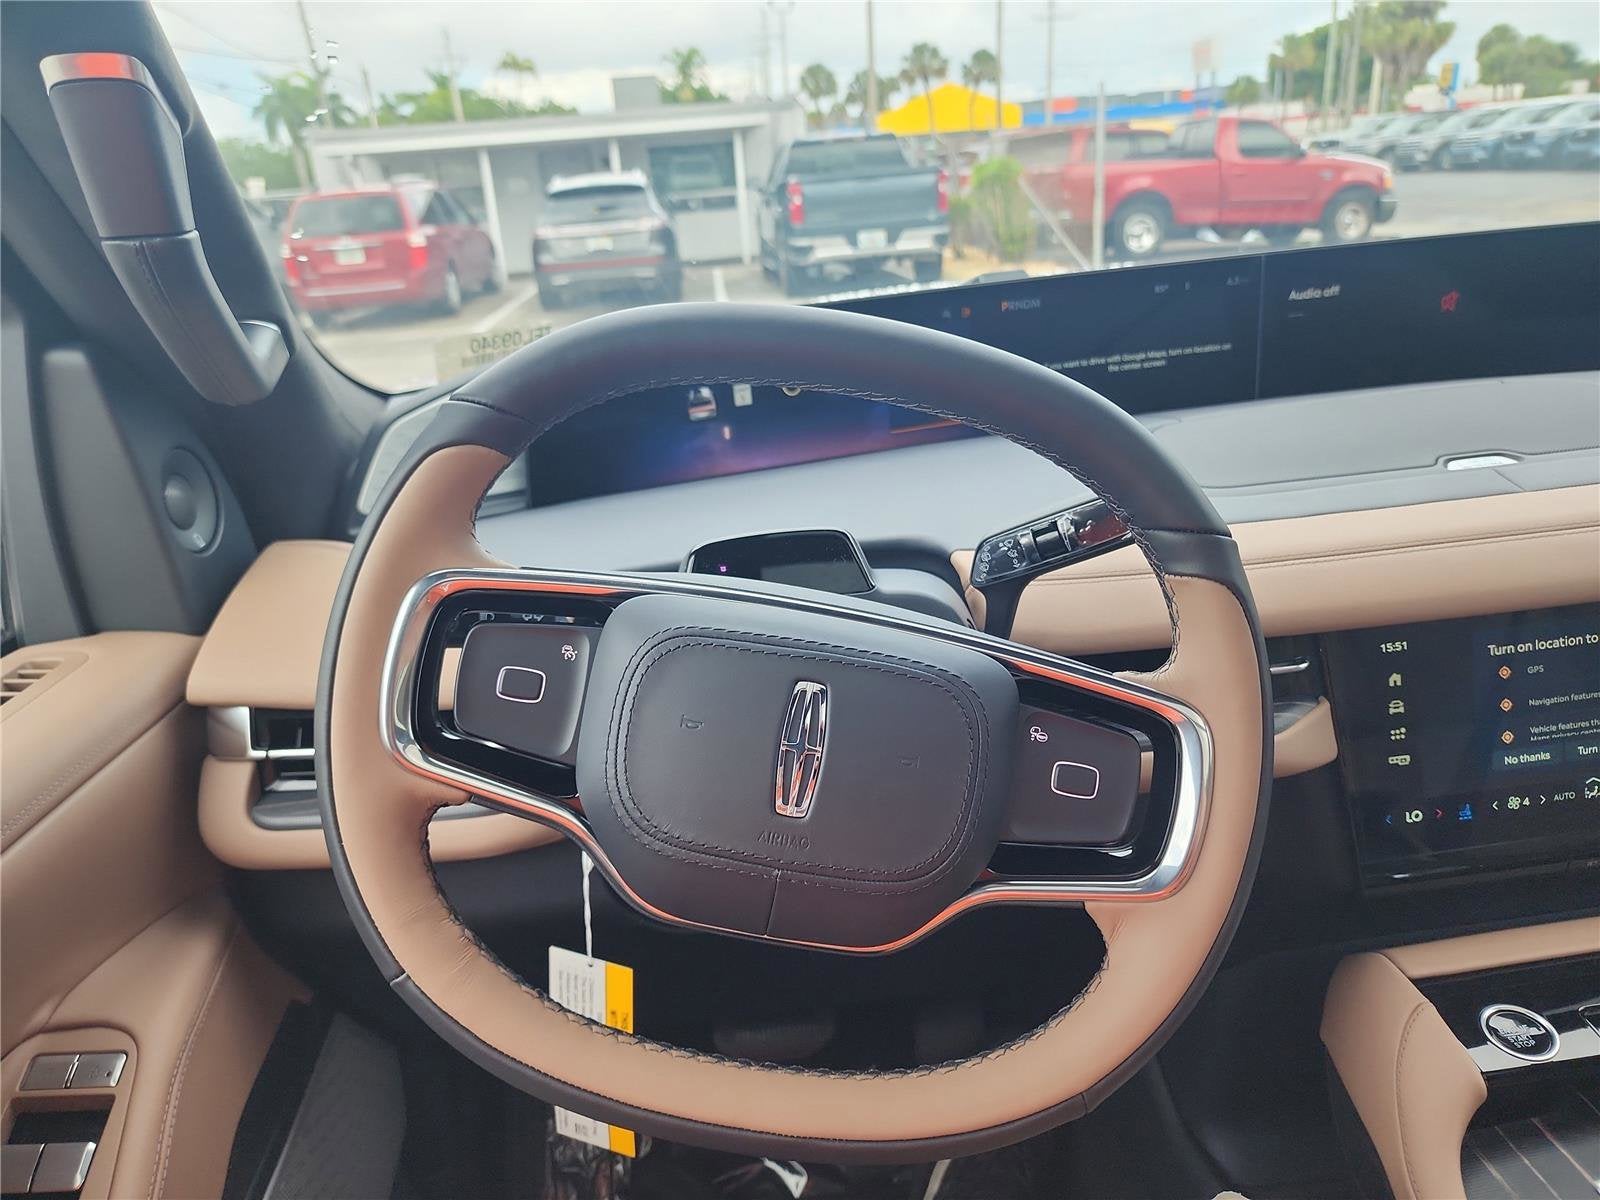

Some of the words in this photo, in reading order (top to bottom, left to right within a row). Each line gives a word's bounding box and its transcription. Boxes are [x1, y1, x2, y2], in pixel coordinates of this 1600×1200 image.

[1288, 286, 1322, 300] Audio
[1323, 284, 1341, 297] off
[1063, 361, 1080, 369] want
[1089, 357, 1106, 366] drive
[1107, 355, 1121, 364] with
[1122, 352, 1146, 363] Google
[1168, 348, 1182, 357] turn
[1194, 344, 1221, 354] location
[1108, 363, 1119, 373] the
[1120, 360, 1141, 371] center
[1143, 358, 1166, 369] screen
[1379, 641, 1408, 653] 15:51
[1488, 644, 1515, 656] Turn
[1517, 642, 1533, 653] on
[1535, 635, 1585, 650] location
[1585, 633, 1599, 645] to
[1527, 665, 1544, 674] GPS
[1528, 695, 1570, 707] Navigation
[1530, 724, 1557, 734] Vehicle
[1558, 721, 1590, 731] features
[1577, 745, 1599, 755] Turn
[1504, 755, 1518, 765] No
[1519, 751, 1551, 763] thanks
[1522, 797, 1530, 806] 4
[1553, 791, 1576, 801] AUTO
[1405, 809, 1424, 823] LO
[757, 831, 811, 850] AIRBAG
[1508, 1034, 1533, 1044] START
[1514, 1040, 1536, 1049] STOP
